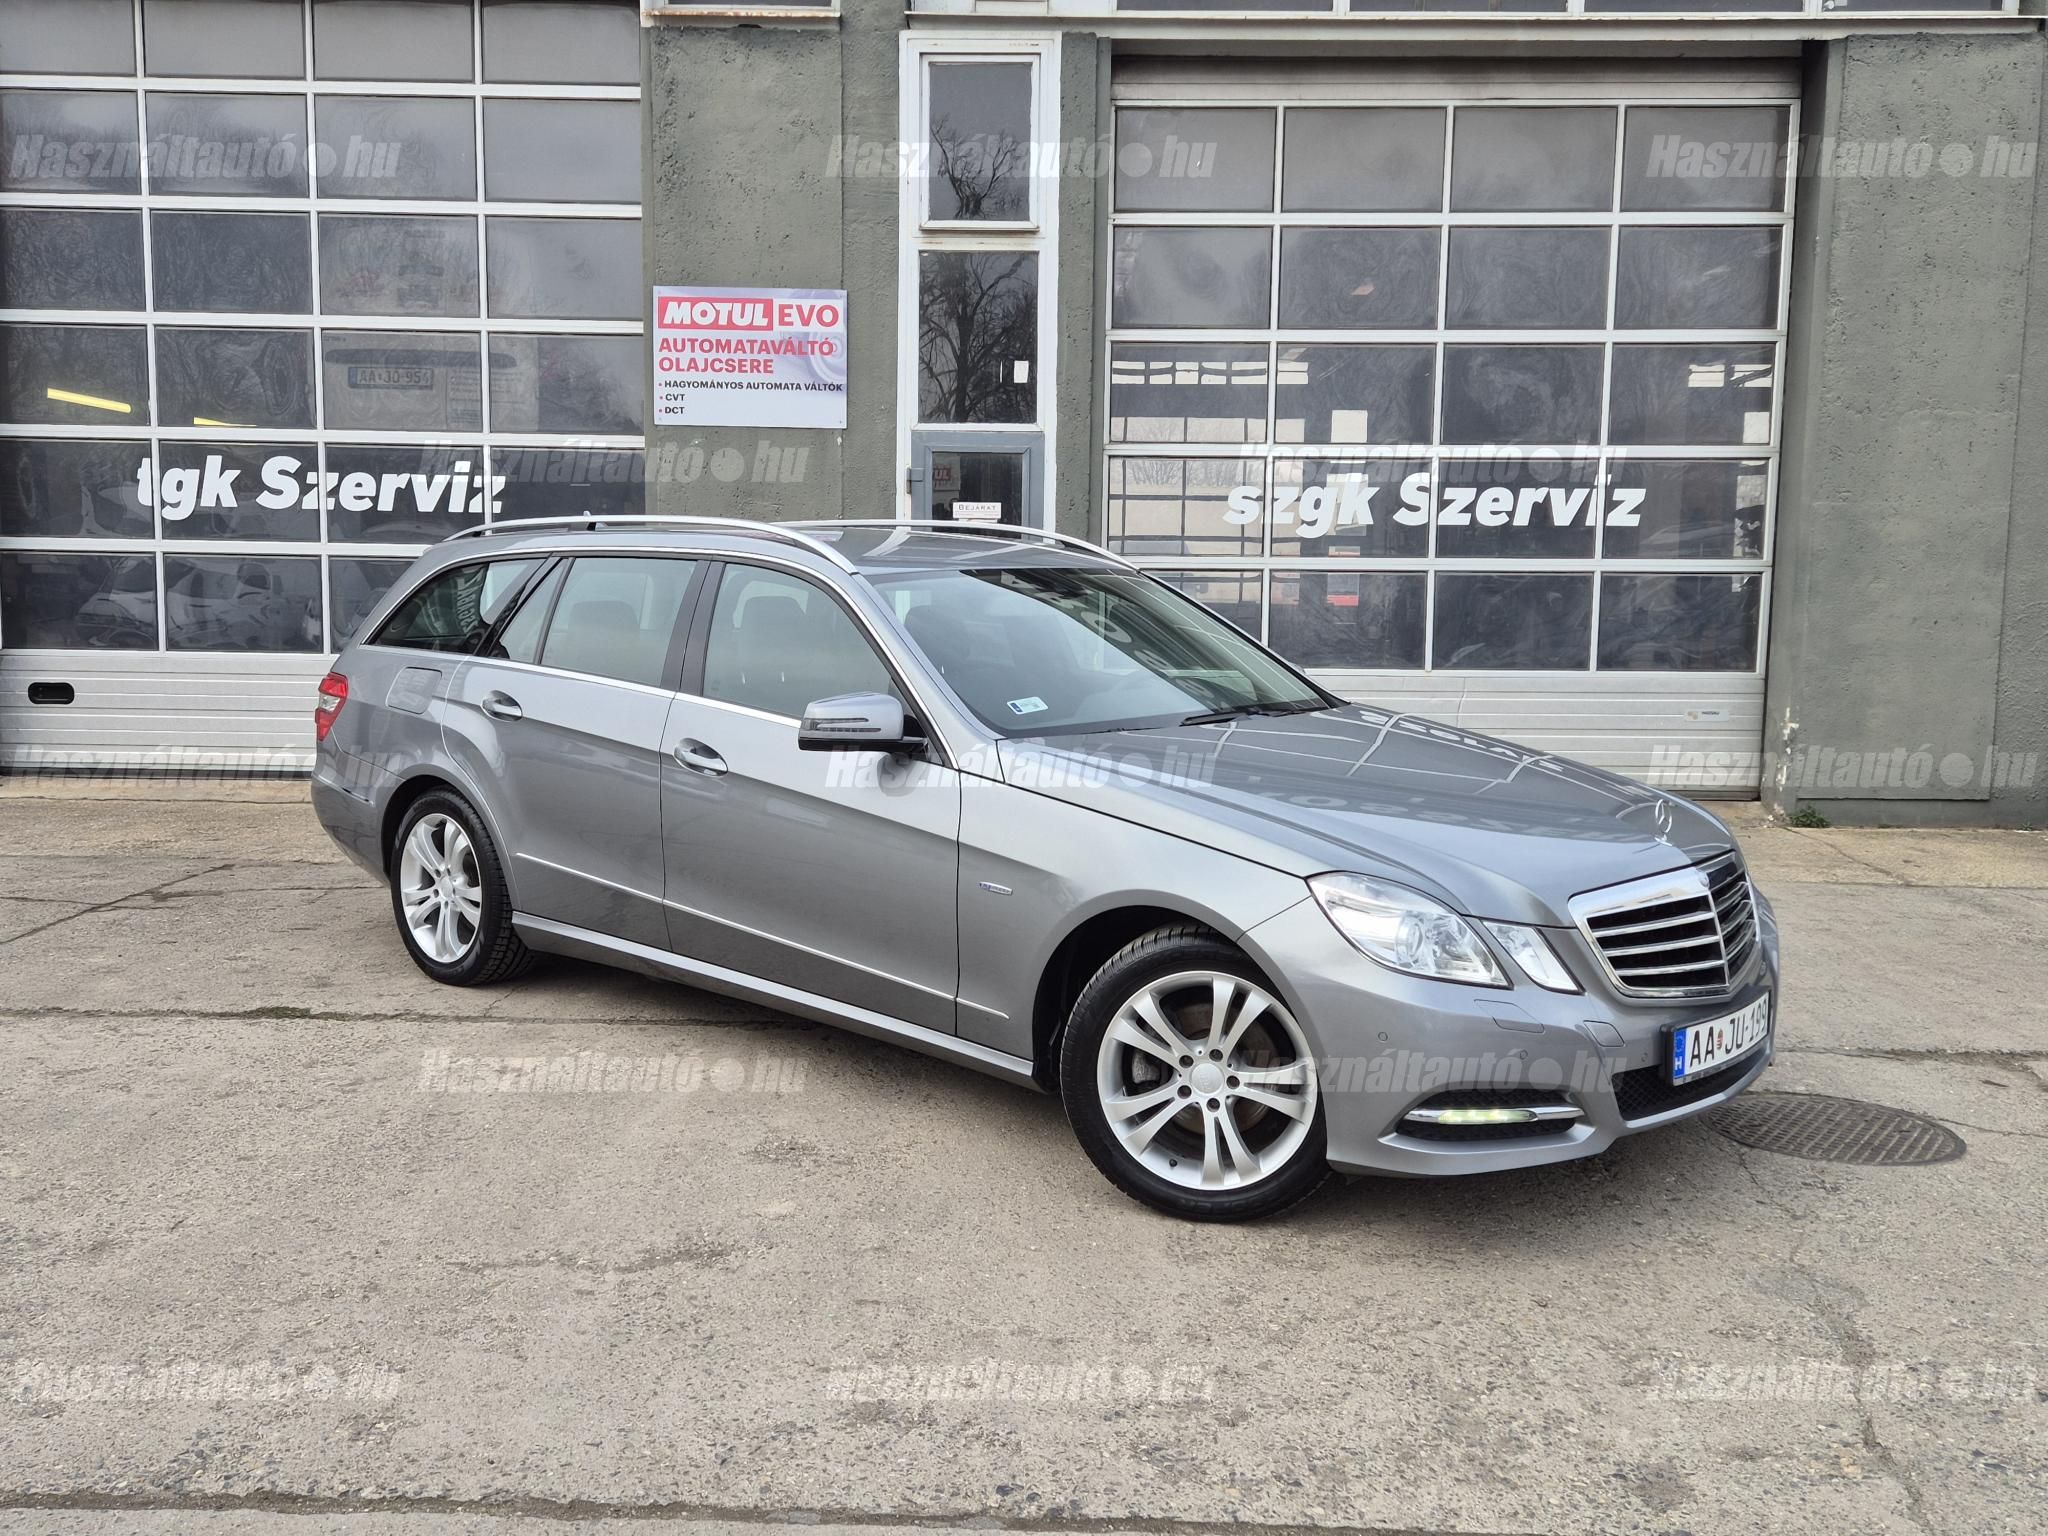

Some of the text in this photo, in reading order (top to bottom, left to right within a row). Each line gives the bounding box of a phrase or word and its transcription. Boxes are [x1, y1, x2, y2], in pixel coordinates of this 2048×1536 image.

[663, 301, 839, 327] MOTUL EVO
[659, 337, 834, 356] AUTOMATAVÁLTÓ
[659, 357, 774, 374] OLAJCSERE
[664, 379, 843, 392] HAGYOMÁNYOS AUTOMATA VÁLTÓK
[136, 455, 506, 521] tgk Szerviz
[1222, 471, 1646, 539] szgk Szerviz
[1690, 998, 1767, 1068] AA JU-199
[1675, 1056, 1683, 1070] H
